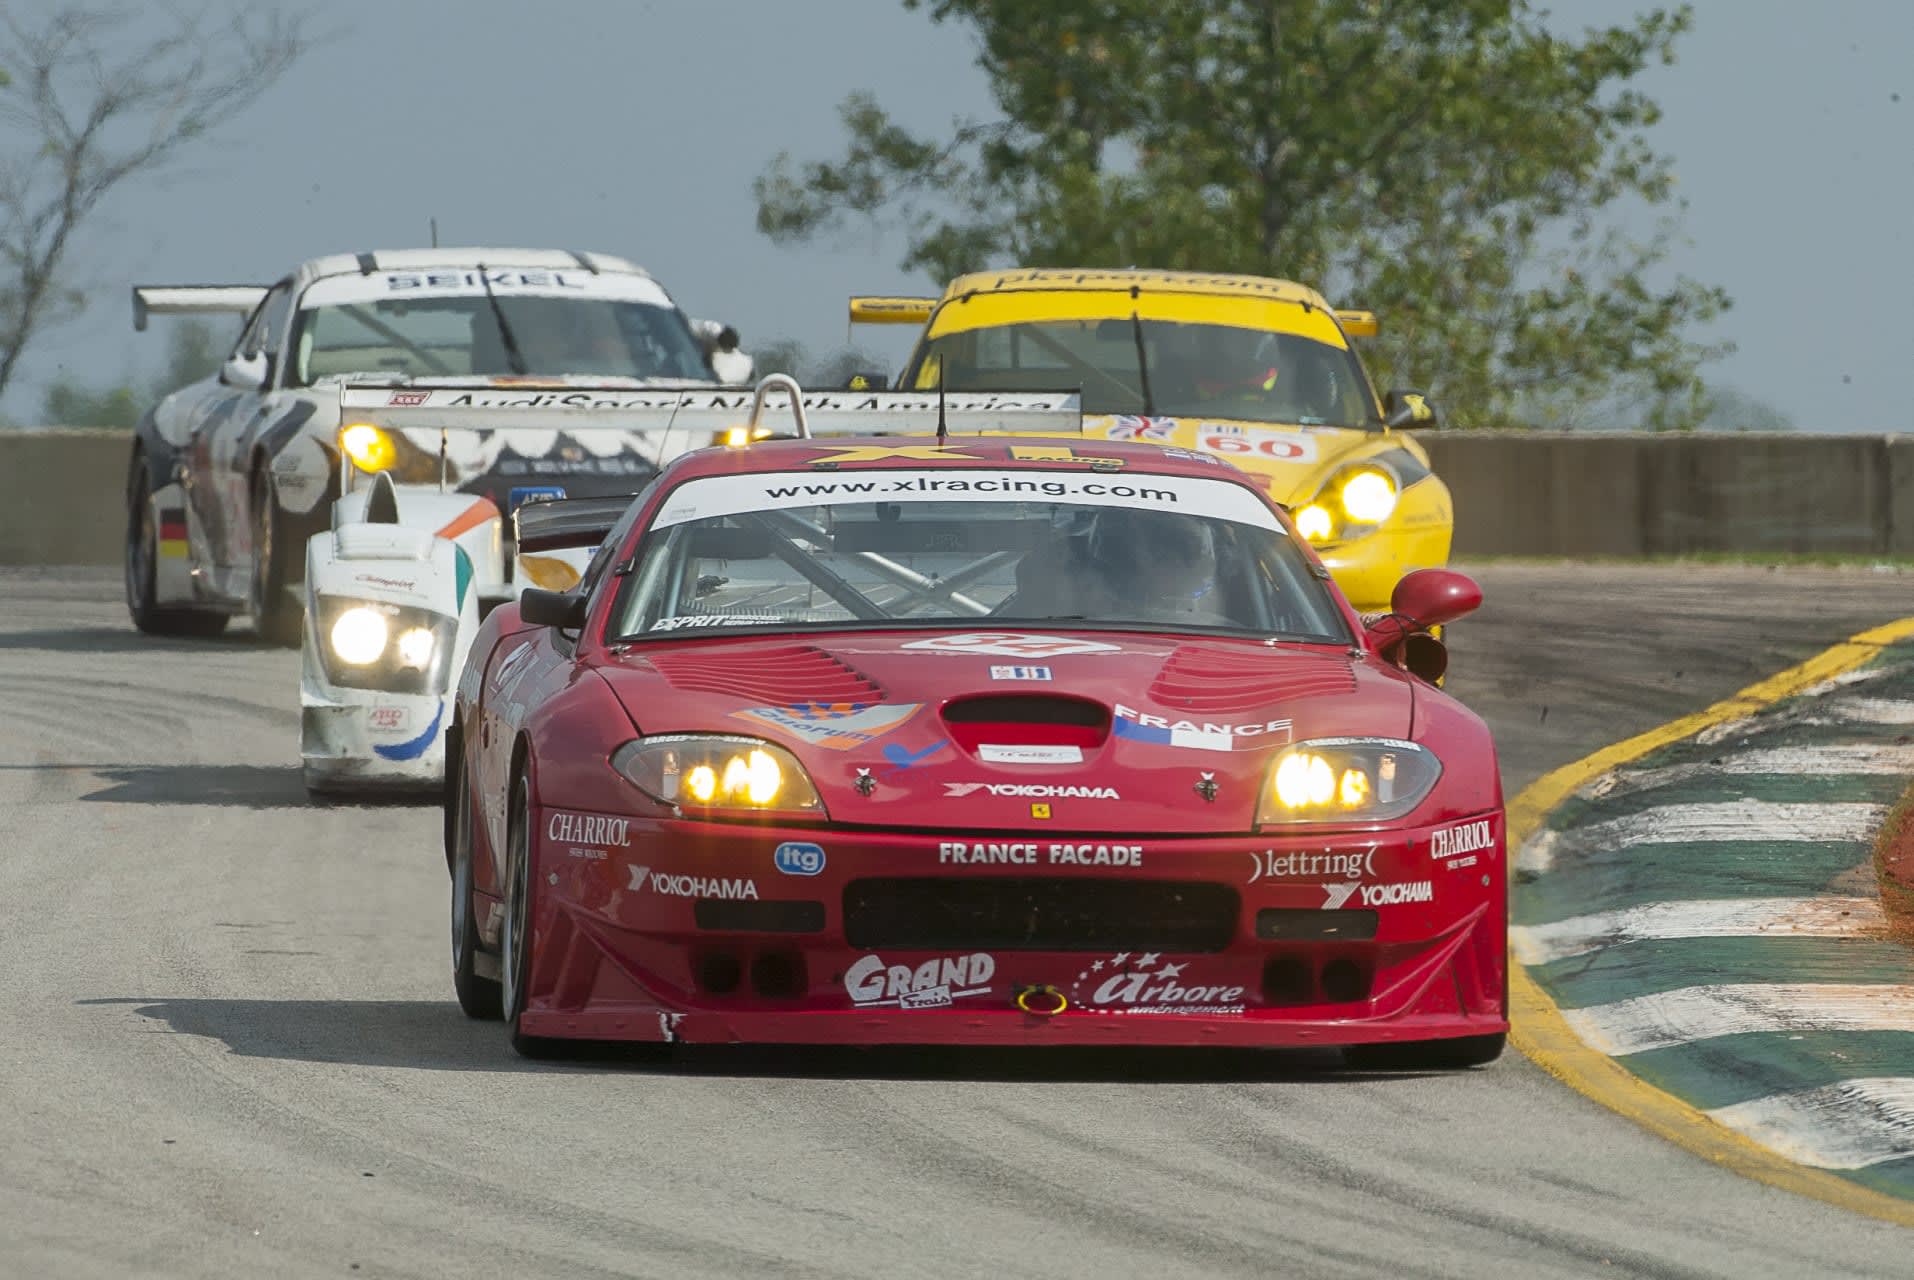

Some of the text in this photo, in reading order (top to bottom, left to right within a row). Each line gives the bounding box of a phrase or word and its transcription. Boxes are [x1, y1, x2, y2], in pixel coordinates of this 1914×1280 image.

[387, 273, 585, 291] SEIKEL
[1205, 436, 1305, 459] 60
[764, 477, 1179, 503] www.xlracing.com
[649, 615, 728, 632] ESPRIT
[752, 707, 873, 741] Quorum
[1114, 703, 1294, 738] FRANCE
[985, 784, 1121, 800] YOKOHAMA
[549, 813, 631, 847] CHARRIOL
[1431, 820, 1494, 860] CHARRIOL
[782, 846, 820, 870] itg
[939, 843, 1143, 866] FRANCE FACADE
[650, 872, 759, 900] YOKOHAMA
[1360, 881, 1433, 906] YOKOHAMA
[844, 953, 995, 1002] GRAND
